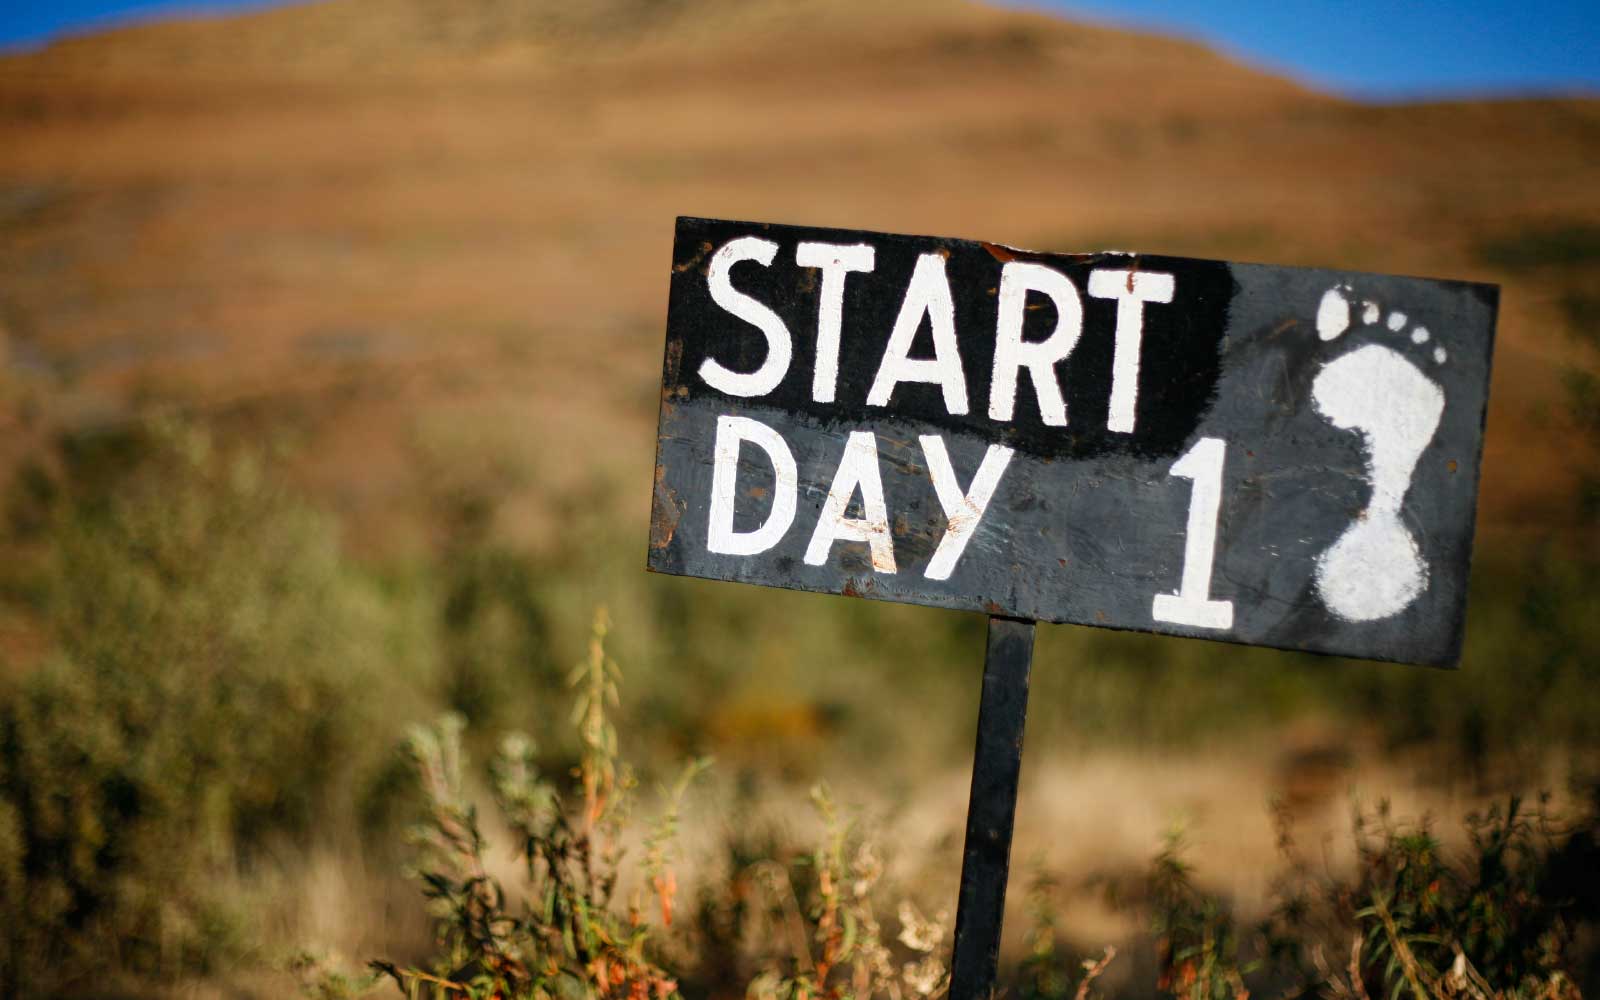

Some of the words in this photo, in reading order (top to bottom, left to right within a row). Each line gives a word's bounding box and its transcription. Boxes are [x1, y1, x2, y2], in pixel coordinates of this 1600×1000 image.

[698, 236, 1176, 434] START
[706, 414, 1014, 582] DAY
[1151, 436, 1235, 631] 1
